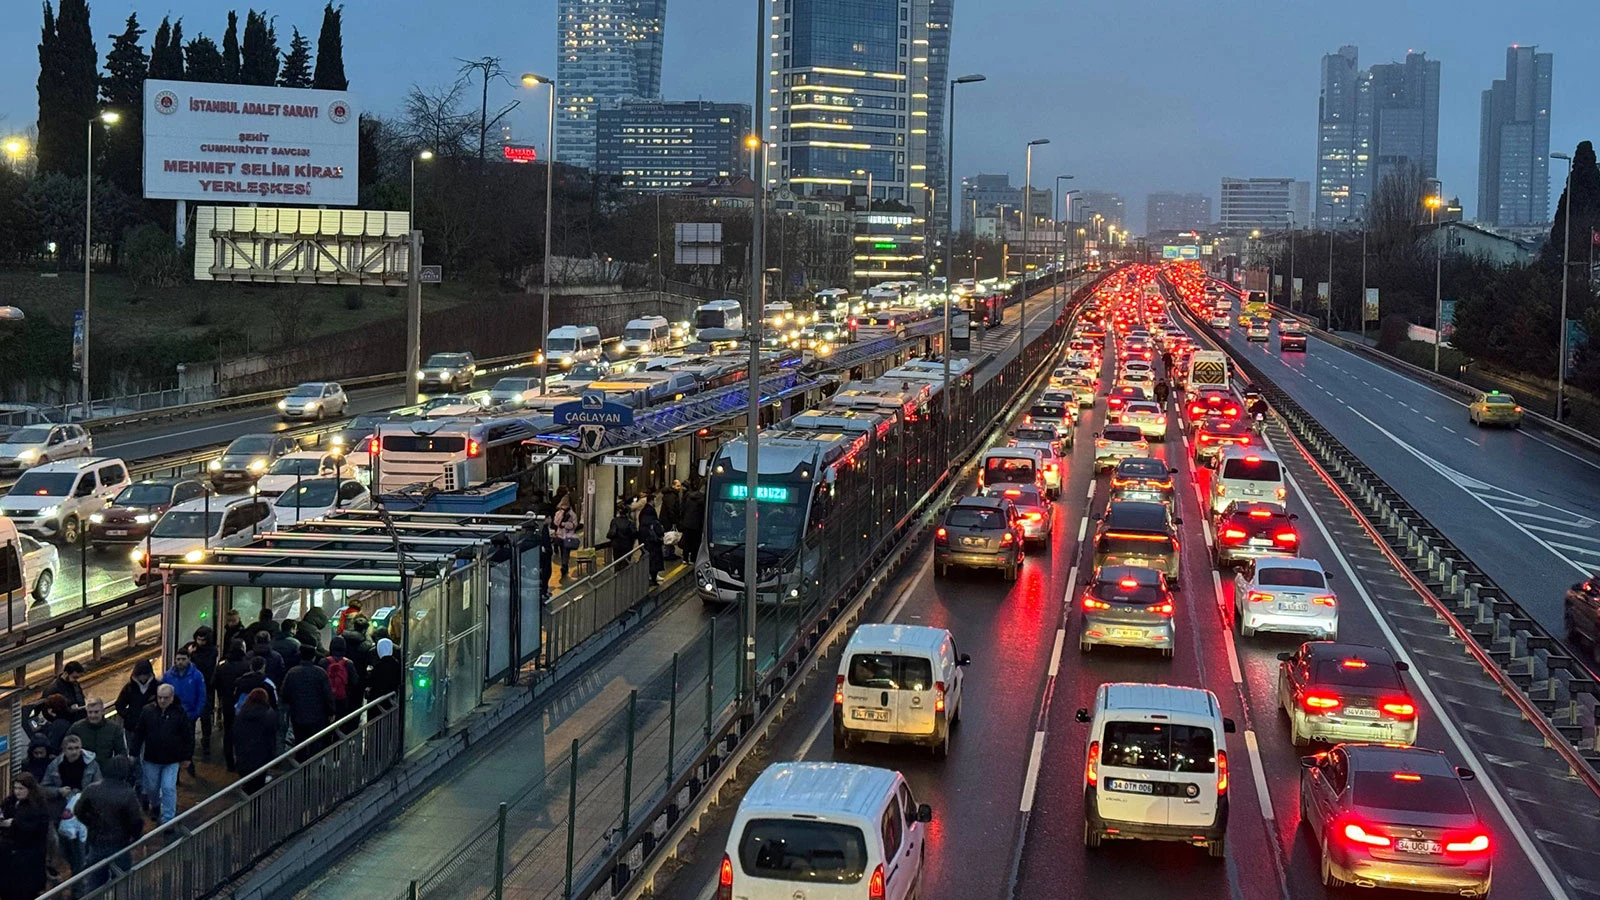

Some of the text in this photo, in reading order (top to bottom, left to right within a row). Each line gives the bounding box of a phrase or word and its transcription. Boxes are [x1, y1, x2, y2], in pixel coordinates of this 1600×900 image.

[190, 96, 240, 114] İSTANBUL
[241, 101, 281, 117] ADALET
[238, 131, 270, 142] ŞEHİT
[200, 143, 270, 155] CUMHURİYET
[163, 159, 236, 174] MEHMET
[240, 161, 290, 177] SELİM
[199, 179, 312, 196] YERLEŞKESİ
[565, 411, 621, 424] ÇAĞLAYAN
[1113, 781, 1122, 789] 34
[1399, 841, 1409, 850] 34
